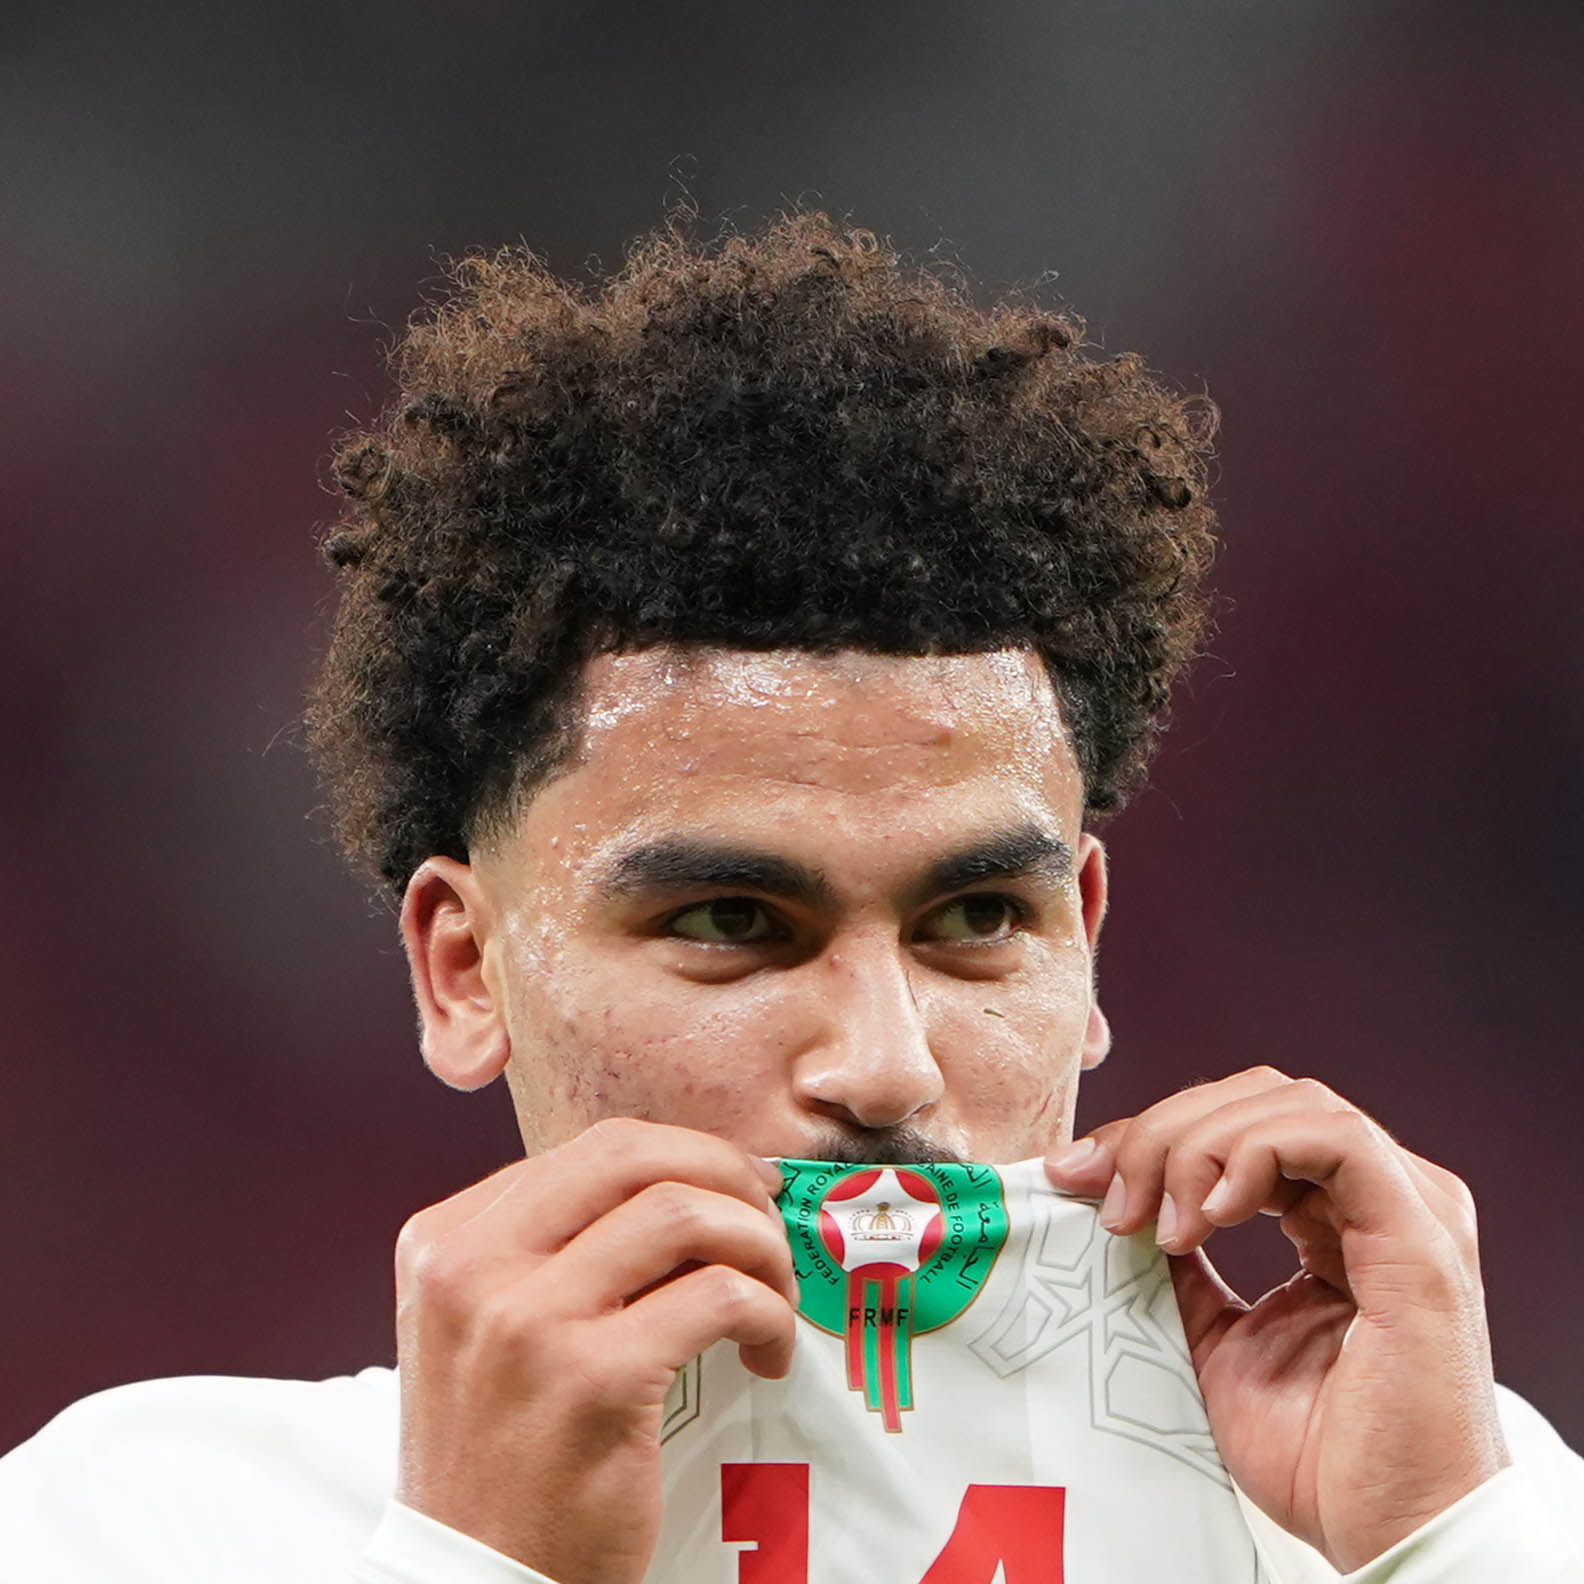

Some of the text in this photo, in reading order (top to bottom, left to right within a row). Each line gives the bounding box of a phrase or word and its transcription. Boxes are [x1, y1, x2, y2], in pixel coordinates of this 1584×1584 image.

[945, 1192, 961, 1212] DE
[797, 1197, 841, 1286] FEDERATION
[919, 1215, 965, 1283] FOOTBALL
[848, 1307, 910, 1329] FRMF
